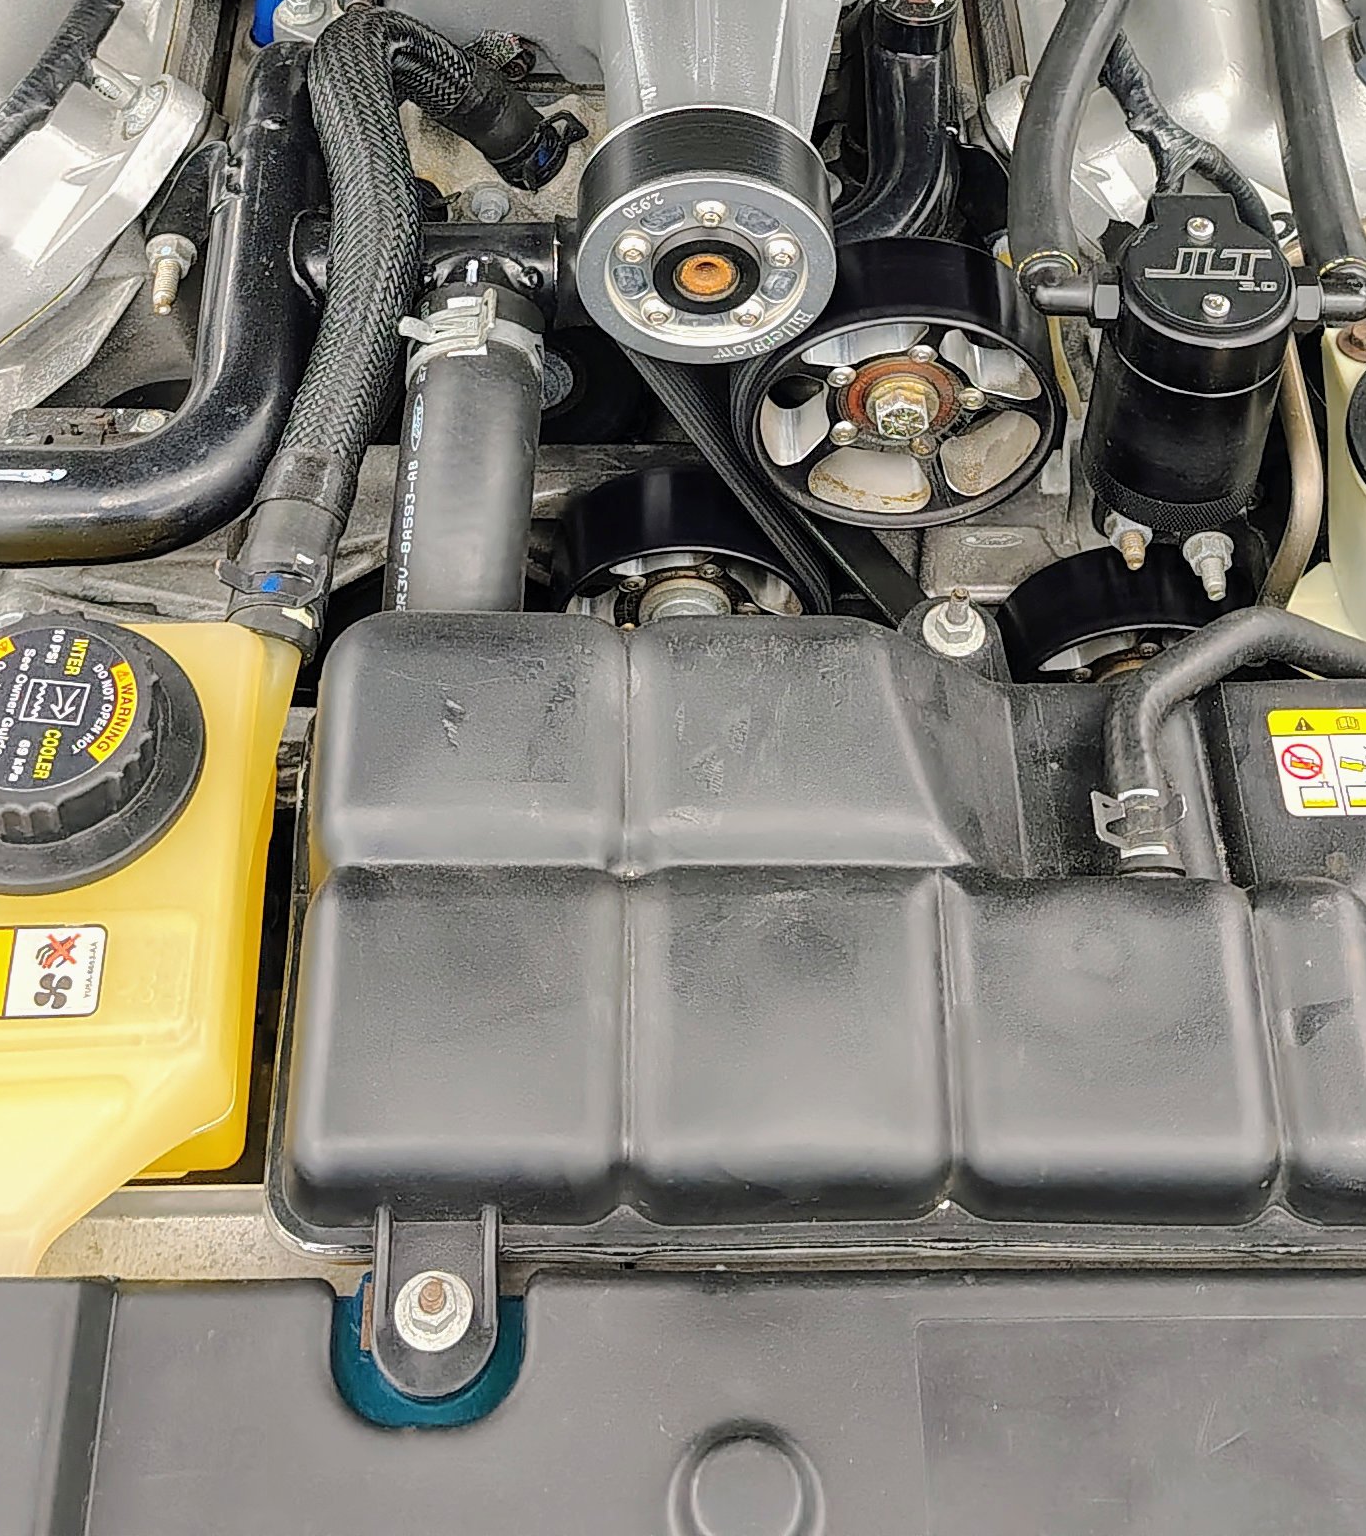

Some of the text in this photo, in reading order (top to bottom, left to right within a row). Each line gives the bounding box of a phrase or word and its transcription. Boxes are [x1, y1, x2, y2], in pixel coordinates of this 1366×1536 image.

[621, 192, 664, 219] 2.930
[1145, 247, 1273, 280] JLT
[1238, 281, 1278, 292] 3.0
[21, 648, 36, 672] See
[44, 629, 65, 664] 10 PSI
[5, 674, 28, 715] Owner
[32, 638, 90, 779] INTER COOLER
[71, 663, 115, 754] DO NOT OPEN HOT
[96, 681, 135, 753] WARNING
[8, 739, 31, 782] 69 kPa
